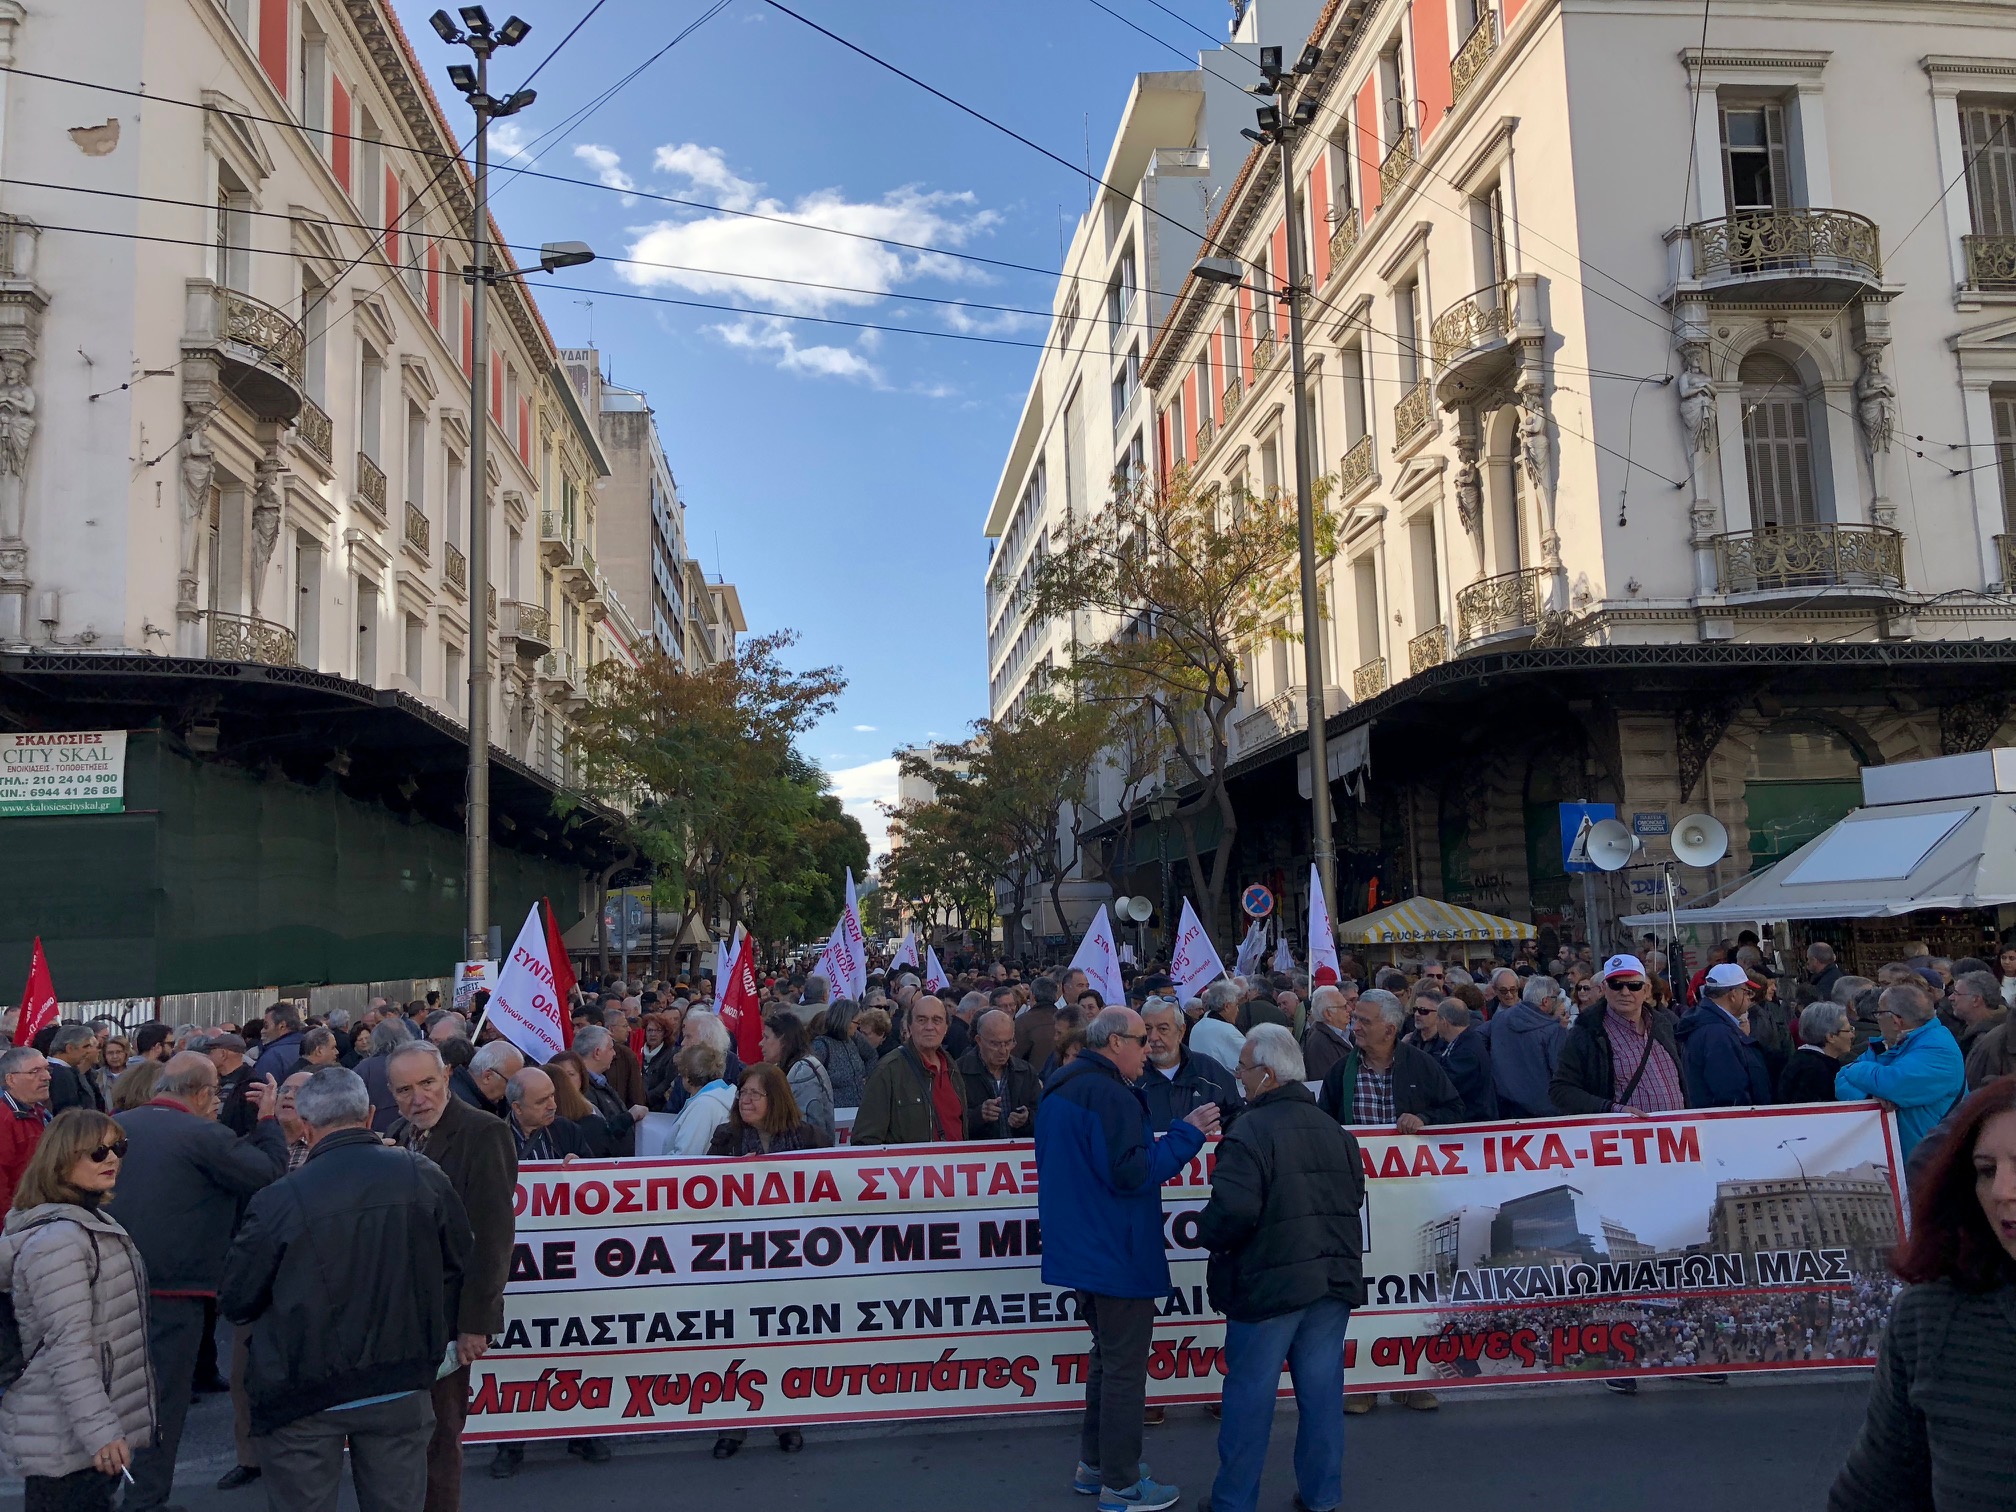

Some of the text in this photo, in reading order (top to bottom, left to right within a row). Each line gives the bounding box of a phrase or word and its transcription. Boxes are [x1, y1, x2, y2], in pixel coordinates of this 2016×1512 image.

[3, 746, 114, 764] CITY SKAL
[15, 733, 103, 746] ΣΚΑΛΩΣΙΕΣ
[7, 763, 109, 773] ΕΝΟΙΚΙΑΣΕΙΣ ΤΟΠΟΘΕΤΗΣΕΙΣ
[32, 776, 55, 785] 210
[58, 775, 74, 784] 24
[77, 774, 92, 784] 04
[96, 773, 118, 783] 900
[1, 801, 111, 813] www.skalosiescityskal.gr
[30, 787, 60, 797] 6944
[64, 787, 79, 797] 41
[83, 786, 98, 796] 26
[103, 786, 118, 795] 86
[512, 946, 557, 995] ΣΥΝΤΑ
[497, 996, 523, 1021] Αθηνών
[522, 1019, 537, 1032] και
[1483, 1126, 1701, 1173] ΙΚΑ-ΕΤΜ
[594, 1236, 676, 1278] ΘΑ
[691, 1222, 962, 1272] ΖΗΣΟΥΜΕ
[1154, 1248, 1851, 1316] ΑΙ ΤΩΝ ΔΙΚΑΙΩΜΑΤΩΝ ΜΑΣ
[491, 1309, 734, 1350] ΑΤΑΣΤΑΣΗ
[750, 1303, 841, 1337] ΤΩΝ
[1371, 1323, 1537, 1375] αγώνες
[1552, 1321, 1637, 1366] μας
[621, 1359, 767, 1418] χωρίς
[781, 1347, 1039, 1399] αυταπάτες
